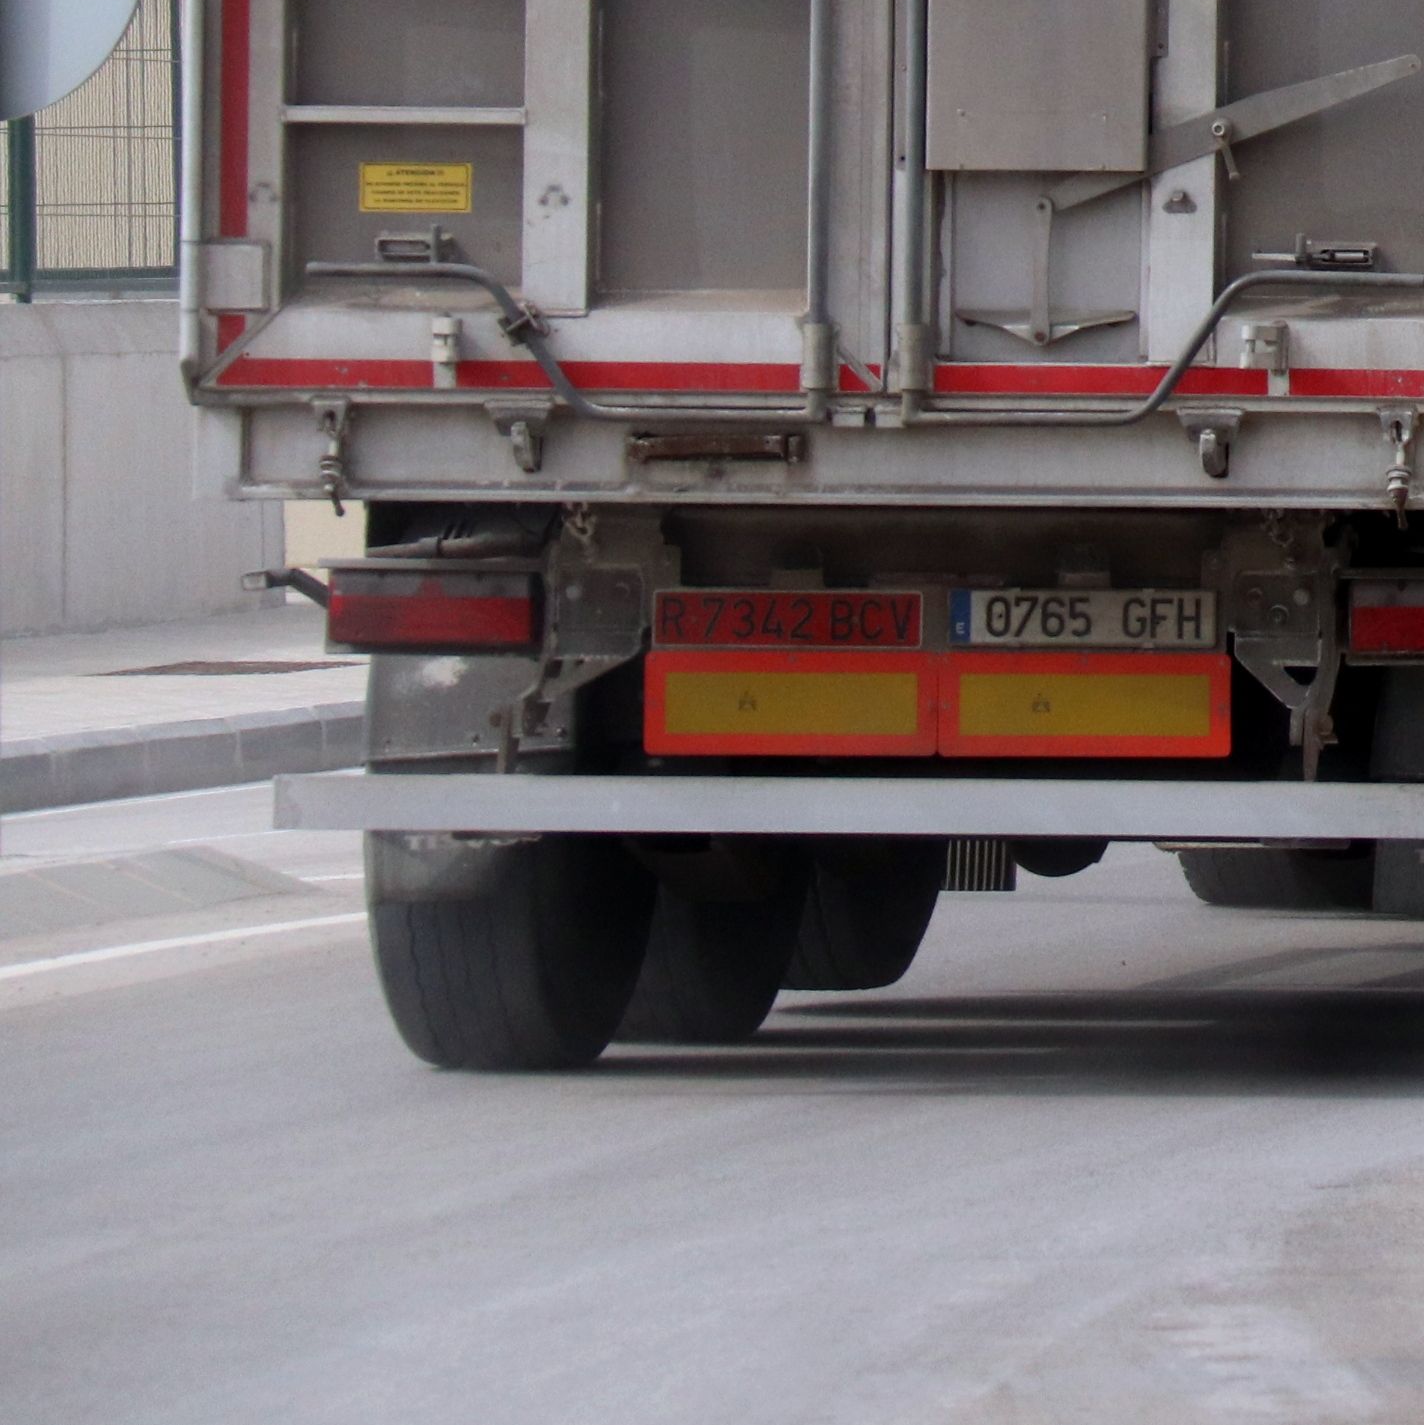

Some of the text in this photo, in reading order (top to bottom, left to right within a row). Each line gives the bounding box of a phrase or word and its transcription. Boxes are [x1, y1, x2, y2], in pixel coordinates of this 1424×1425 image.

[660, 598, 917, 643] R 7342 BCV
[985, 596, 1203, 642] 0765 GFH
